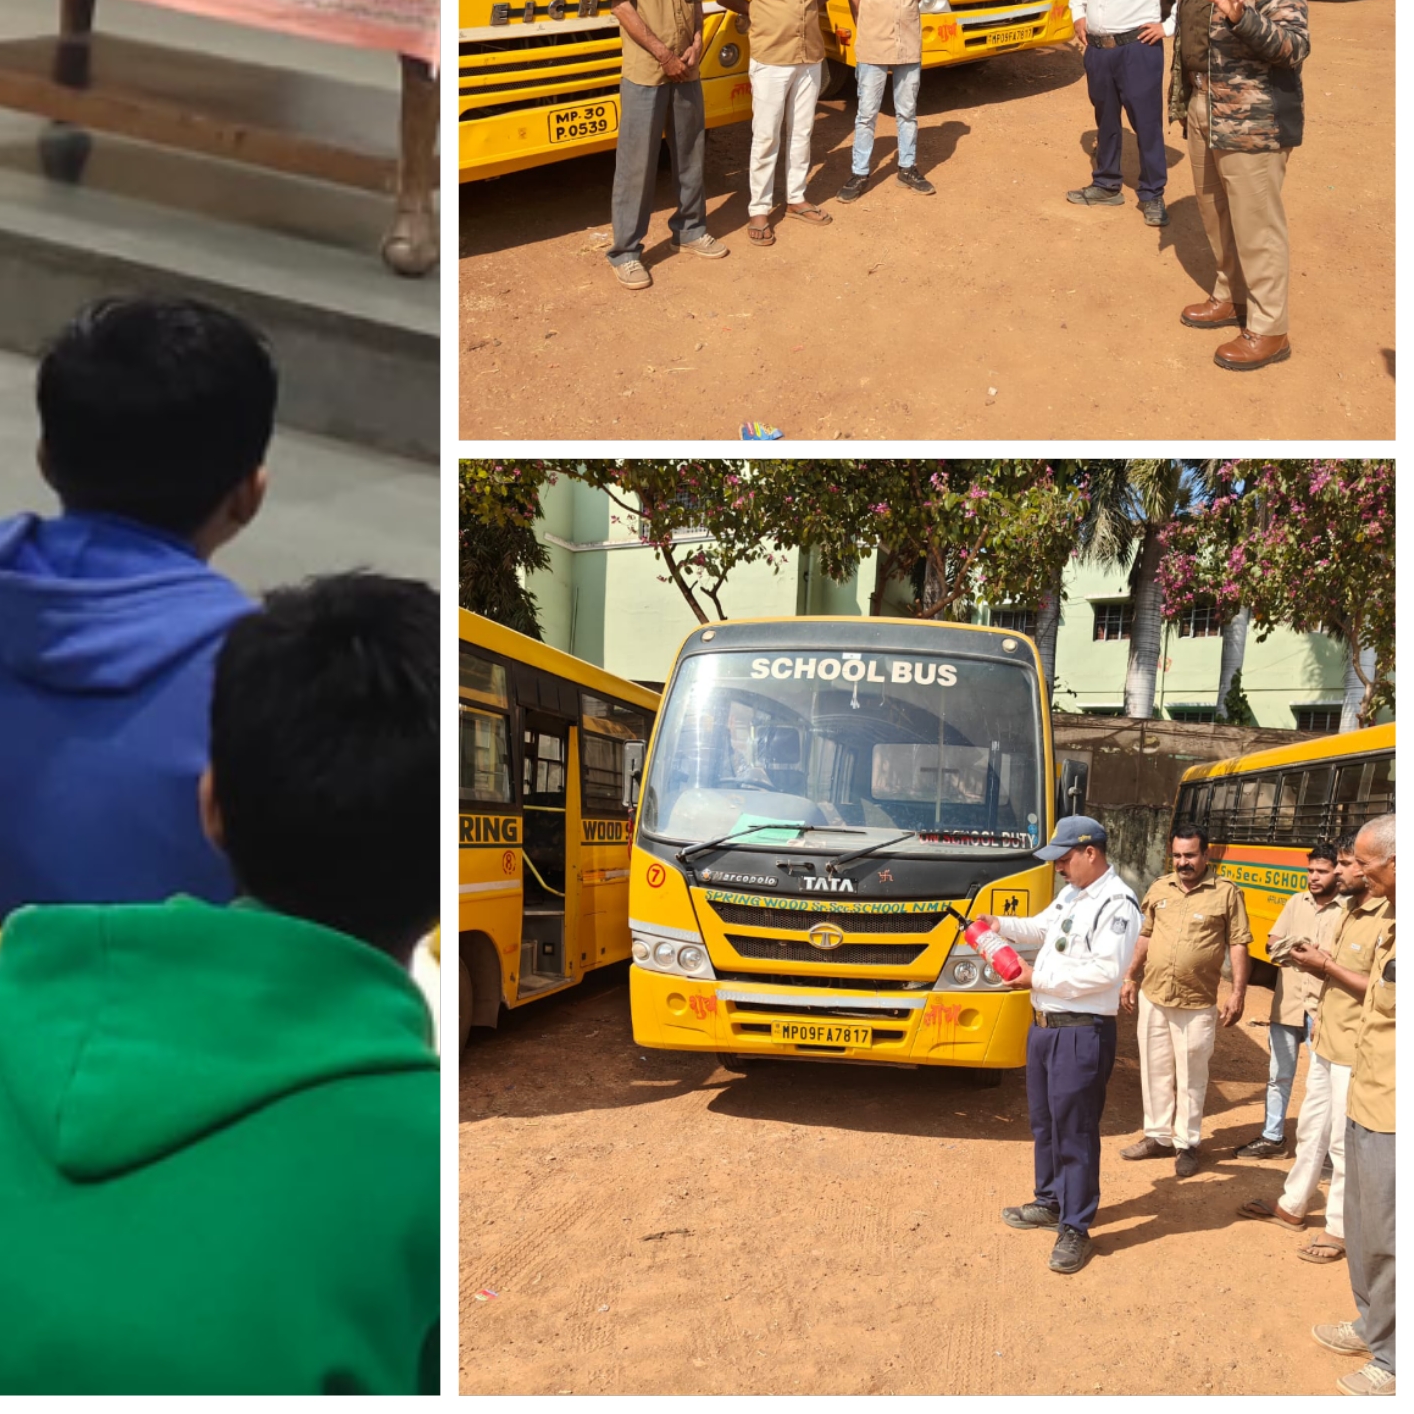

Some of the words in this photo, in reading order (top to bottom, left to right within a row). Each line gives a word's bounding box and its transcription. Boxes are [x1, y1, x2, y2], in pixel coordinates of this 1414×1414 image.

[750, 657, 885, 683] SCHOOL
[891, 661, 958, 686] BUS
[459, 816, 518, 843] RING
[583, 820, 622, 841] WOOD
[1002, 831, 1036, 850] DUTY
[651, 868, 661, 883] 7
[713, 871, 776, 886] Marcopolo
[803, 876, 855, 893] TATA
[1265, 870, 1309, 890] SCHOO
[704, 889, 762, 907] SPRING
[764, 898, 809, 912] WOOD
[912, 901, 952, 913] NMH
[782, 1025, 869, 1044] MP09FA7817
